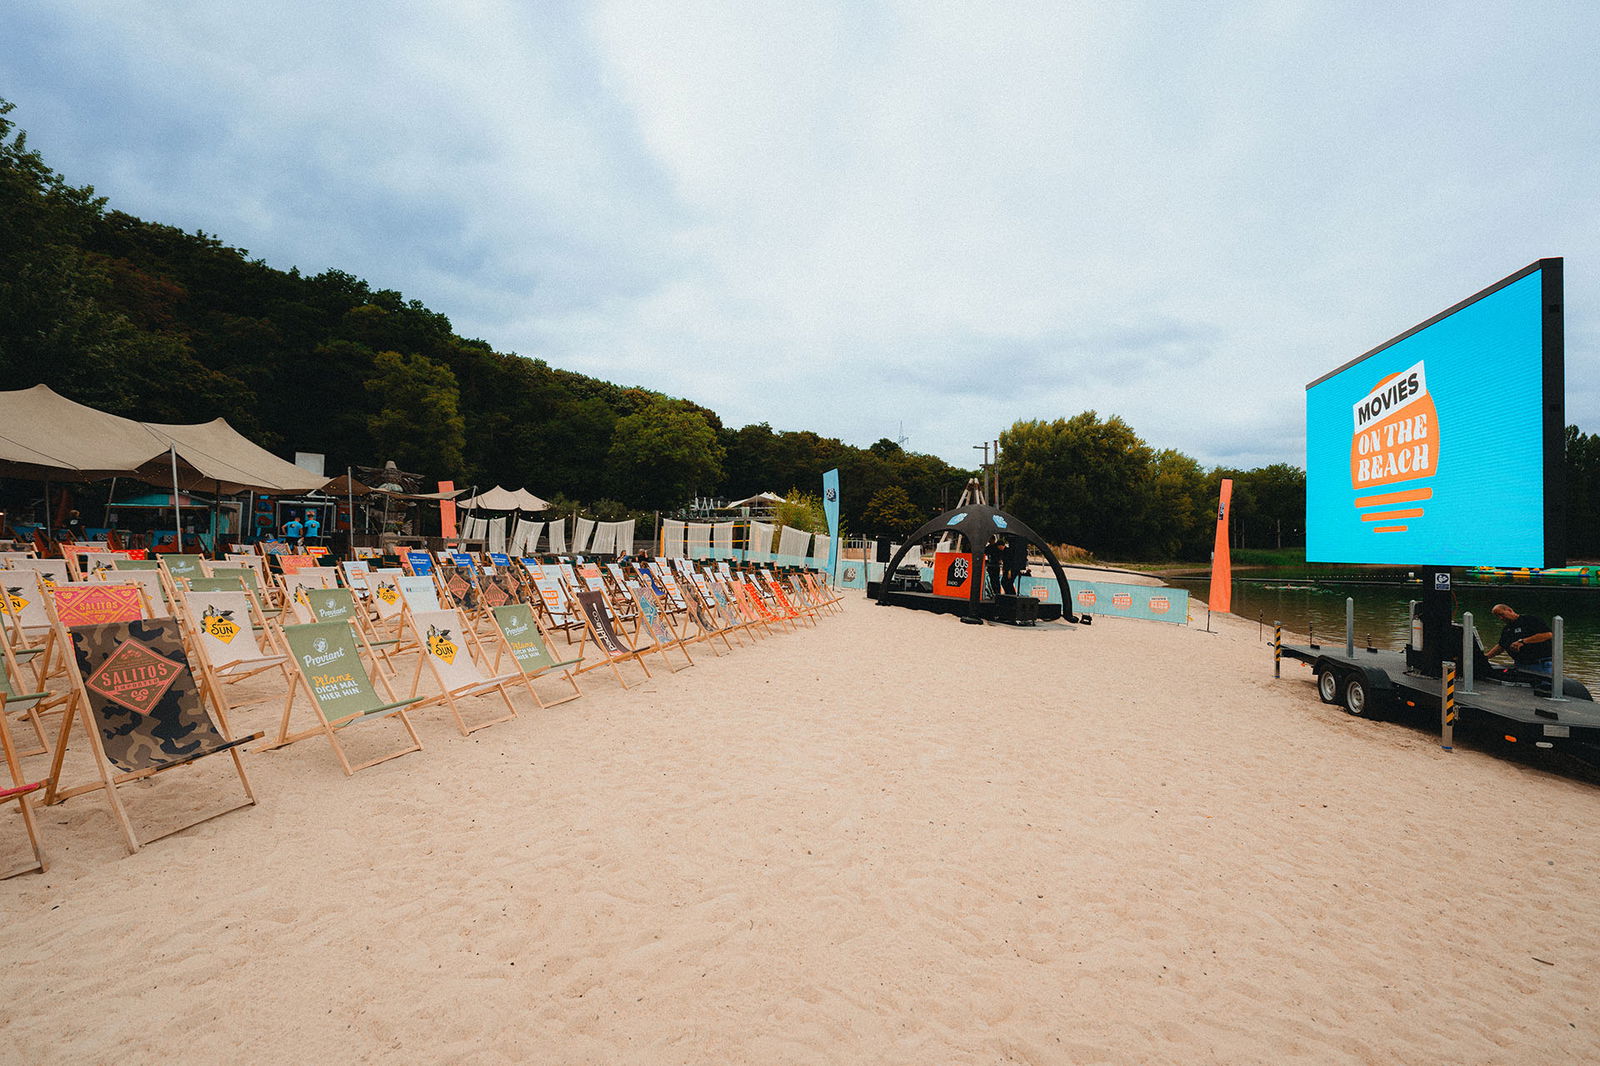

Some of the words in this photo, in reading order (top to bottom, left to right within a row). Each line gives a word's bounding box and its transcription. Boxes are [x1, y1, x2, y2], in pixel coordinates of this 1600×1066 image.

[1358, 372, 1419, 426] MOVIES
[1358, 429, 1381, 456] ON
[1383, 413, 1428, 448] THE
[1357, 443, 1430, 482] BEACH
[954, 557, 969, 569] 80s
[953, 567, 969, 579] 80s
[79, 600, 119, 611] SALITOS
[319, 606, 347, 618] Proviant
[211, 623, 234, 635] SUN
[435, 644, 454, 656] SUN
[303, 646, 345, 668] Proviant
[101, 662, 168, 687] SALITOS
[315, 684, 339, 694] DICH
[339, 679, 359, 690] MAL
[320, 690, 342, 702] HIER
